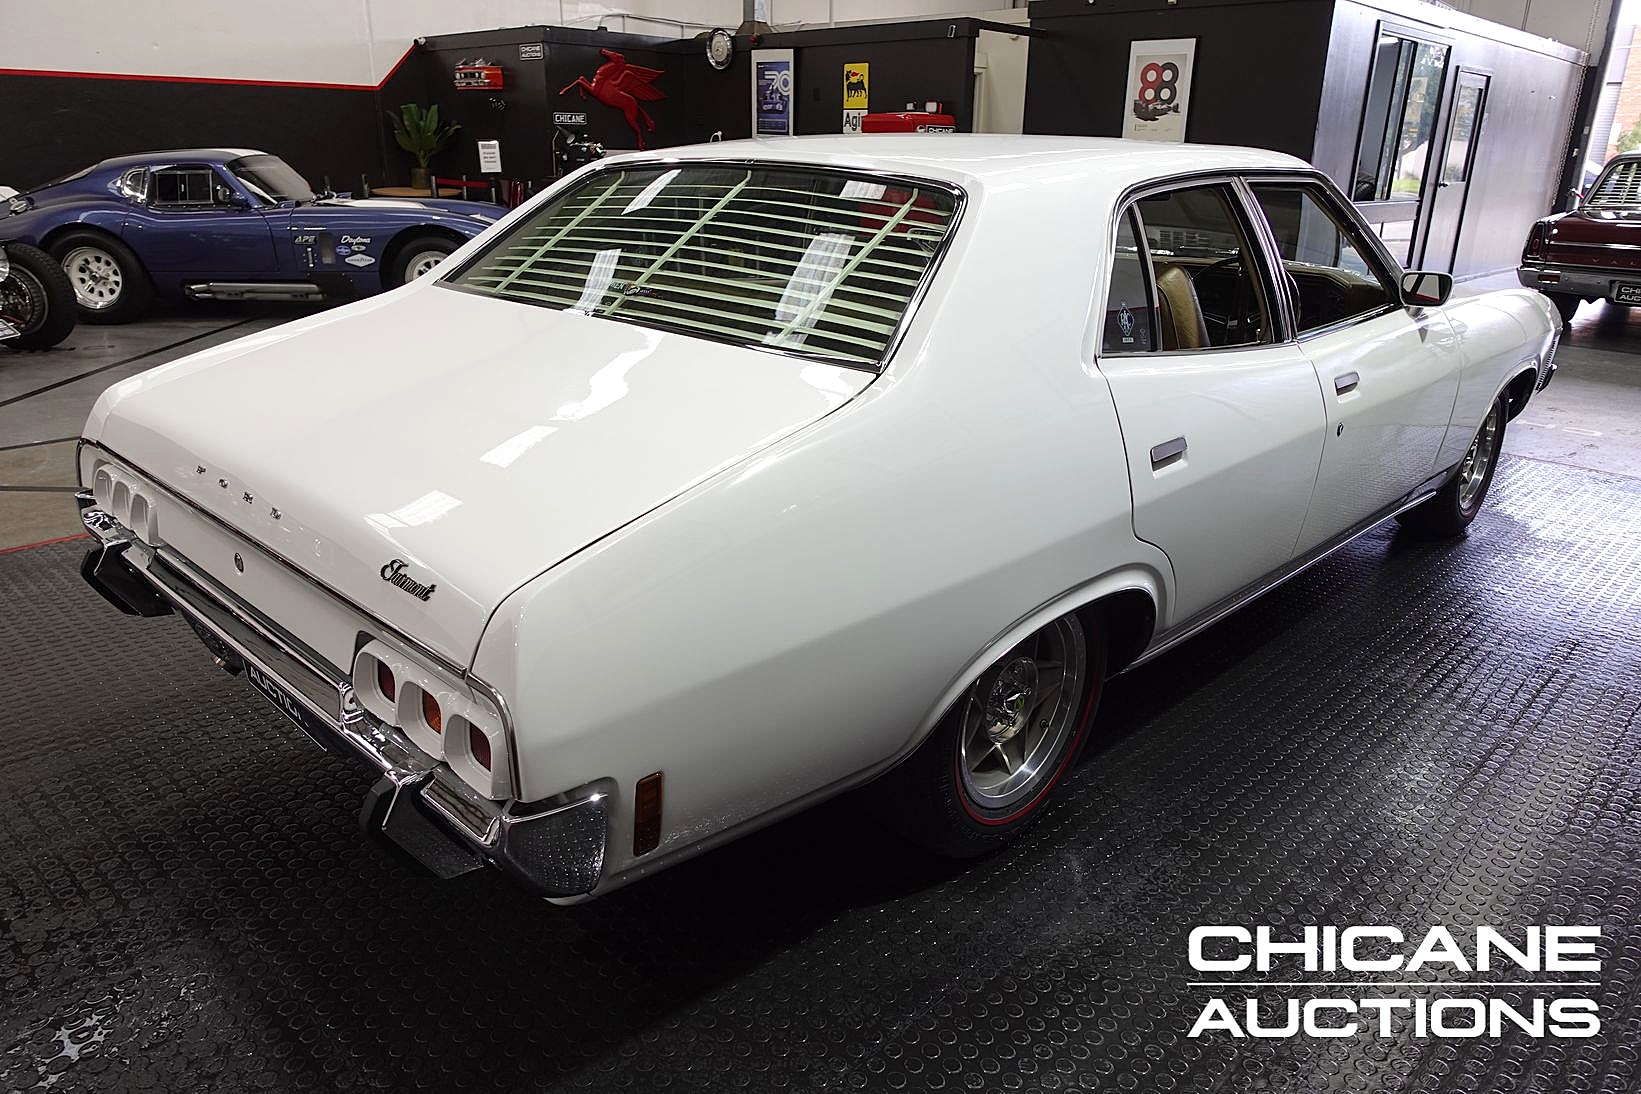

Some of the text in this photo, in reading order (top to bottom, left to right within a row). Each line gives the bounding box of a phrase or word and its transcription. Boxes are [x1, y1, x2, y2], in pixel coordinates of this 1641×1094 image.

[764, 71, 790, 95] 70
[1138, 62, 1179, 106] 88
[844, 112, 864, 132] Agi
[340, 236, 371, 246] Daytona
[380, 559, 437, 602] Fairmont
